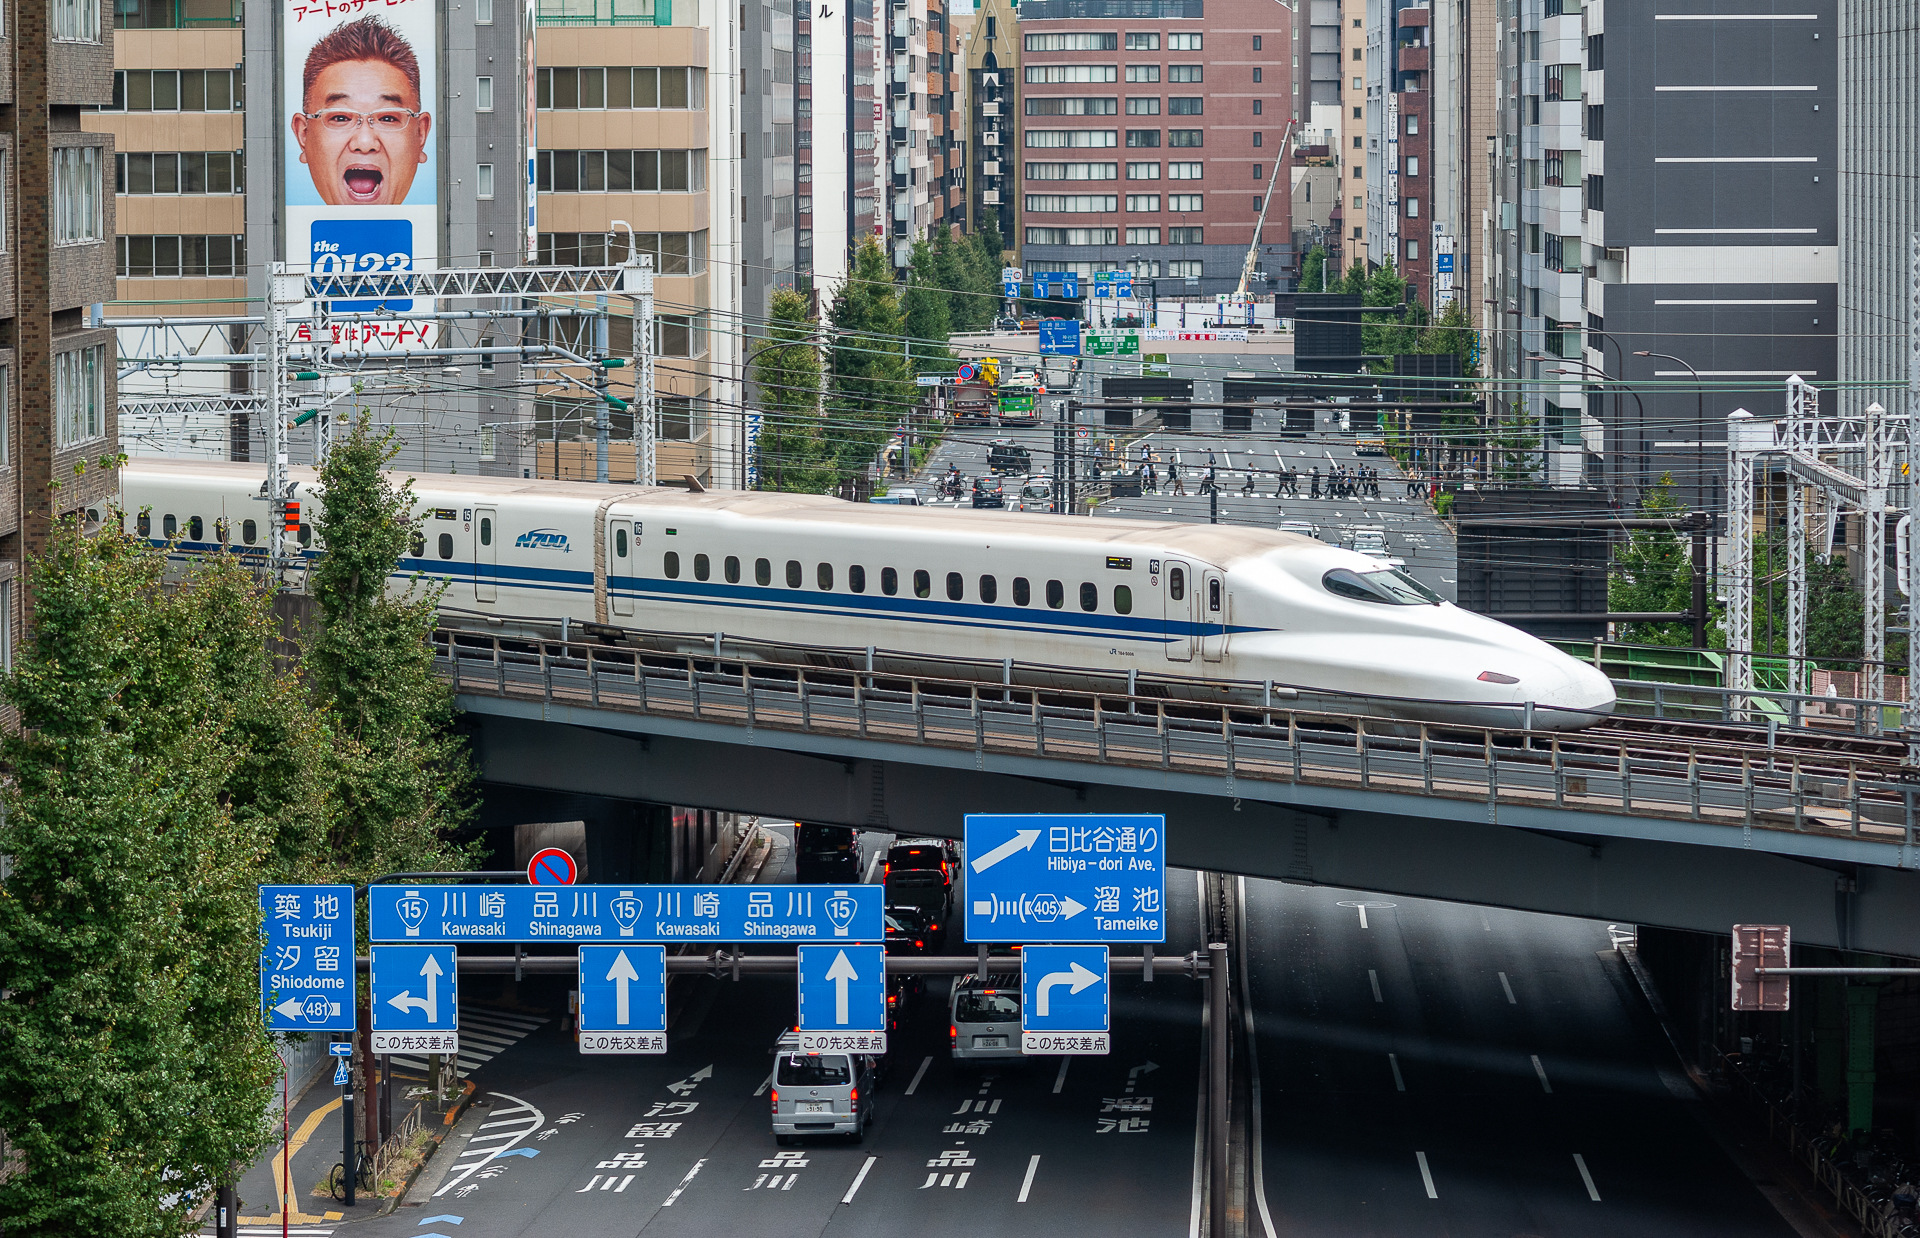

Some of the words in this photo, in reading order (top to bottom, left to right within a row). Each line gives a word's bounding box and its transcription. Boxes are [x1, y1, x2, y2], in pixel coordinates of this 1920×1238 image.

[292, 0, 416, 23] アートのサー
[818, 4, 833, 19] ル
[313, 240, 340, 253] the
[313, 252, 411, 286] 0123
[464, 510, 471, 521] 15
[635, 524, 642, 534] 16
[1150, 560, 1159, 573] 16
[1233, 797, 1241, 812] 2
[1049, 826, 1158, 854] 日比谷通り
[1047, 856, 1123, 874] Hibiya-dori
[1127, 856, 1156, 872] Ave.
[402, 901, 422, 919] 15
[441, 891, 506, 918] 川崎
[533, 891, 597, 918] 品川
[615, 901, 636, 919] 15
[655, 891, 720, 918] 川崎
[747, 891, 812, 918] 品川
[830, 901, 850, 919] 15
[1093, 885, 1159, 913] 溜池
[274, 893, 340, 921] 築地
[1034, 901, 1057, 916] 405
[441, 921, 506, 936] Kawasaki
[529, 921, 602, 938] Shinagawa
[655, 921, 720, 936] Kawasaki
[743, 921, 816, 938] Shinagawa
[1093, 916, 1159, 931] Tameike
[282, 924, 332, 941] Tsukiji
[275, 945, 340, 971] 汐留
[270, 974, 345, 989] Shiodome
[305, 1003, 328, 1017] 481
[374, 1036, 455, 1051] この先交差点
[583, 1036, 664, 1051] この先交差点
[802, 1036, 884, 1051] この先交差点
[1025, 1037, 1107, 1051] この先交差点
[743, 1151, 811, 1191] 品川
